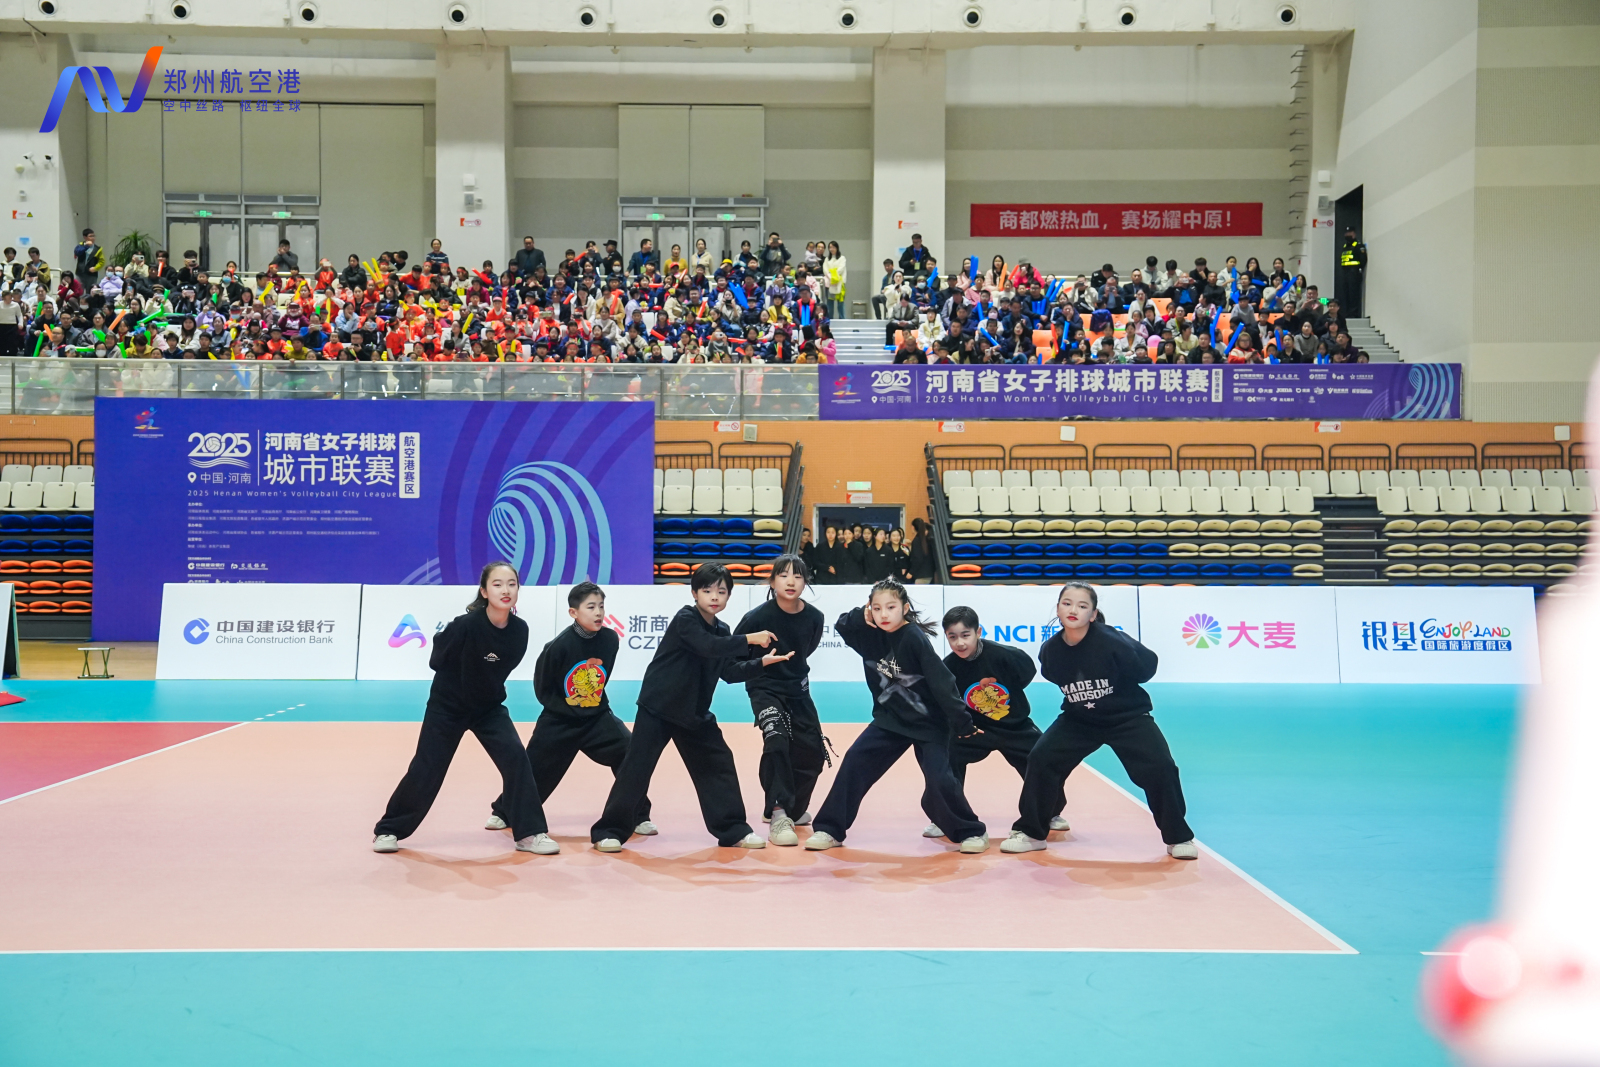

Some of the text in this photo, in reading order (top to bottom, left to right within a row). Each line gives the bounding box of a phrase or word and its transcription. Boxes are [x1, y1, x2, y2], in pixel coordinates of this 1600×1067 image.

[871, 370, 912, 387] 2025
[926, 369, 1209, 393] 河南省女子排球城市联赛
[961, 395, 997, 403] Henan
[1004, 394, 1057, 403] Women's
[1064, 394, 1126, 404] Volleyball
[1133, 394, 1158, 404] City
[1165, 394, 1208, 404] League
[187, 432, 252, 457] 2025
[265, 432, 397, 452] 河南省女子排球
[263, 454, 396, 485] 城市联赛
[404, 436, 415, 494] 航空港赛区
[200, 472, 252, 484] 中国·河南
[187, 489, 209, 497] 2025
[291, 490, 338, 498] Volleyball
[342, 490, 360, 498] City
[364, 490, 397, 498] League
[216, 620, 336, 633] 中国建设银行
[994, 625, 1035, 642] NCI
[1227, 621, 1297, 649] 大麦
[215, 635, 334, 644] China Construction Bank
[1361, 621, 1418, 651] 银基
[1424, 640, 1509, 651] 国际旅游度假区
[1061, 678, 1109, 694] MADE IN
[1066, 686, 1114, 703] ANDSOME
